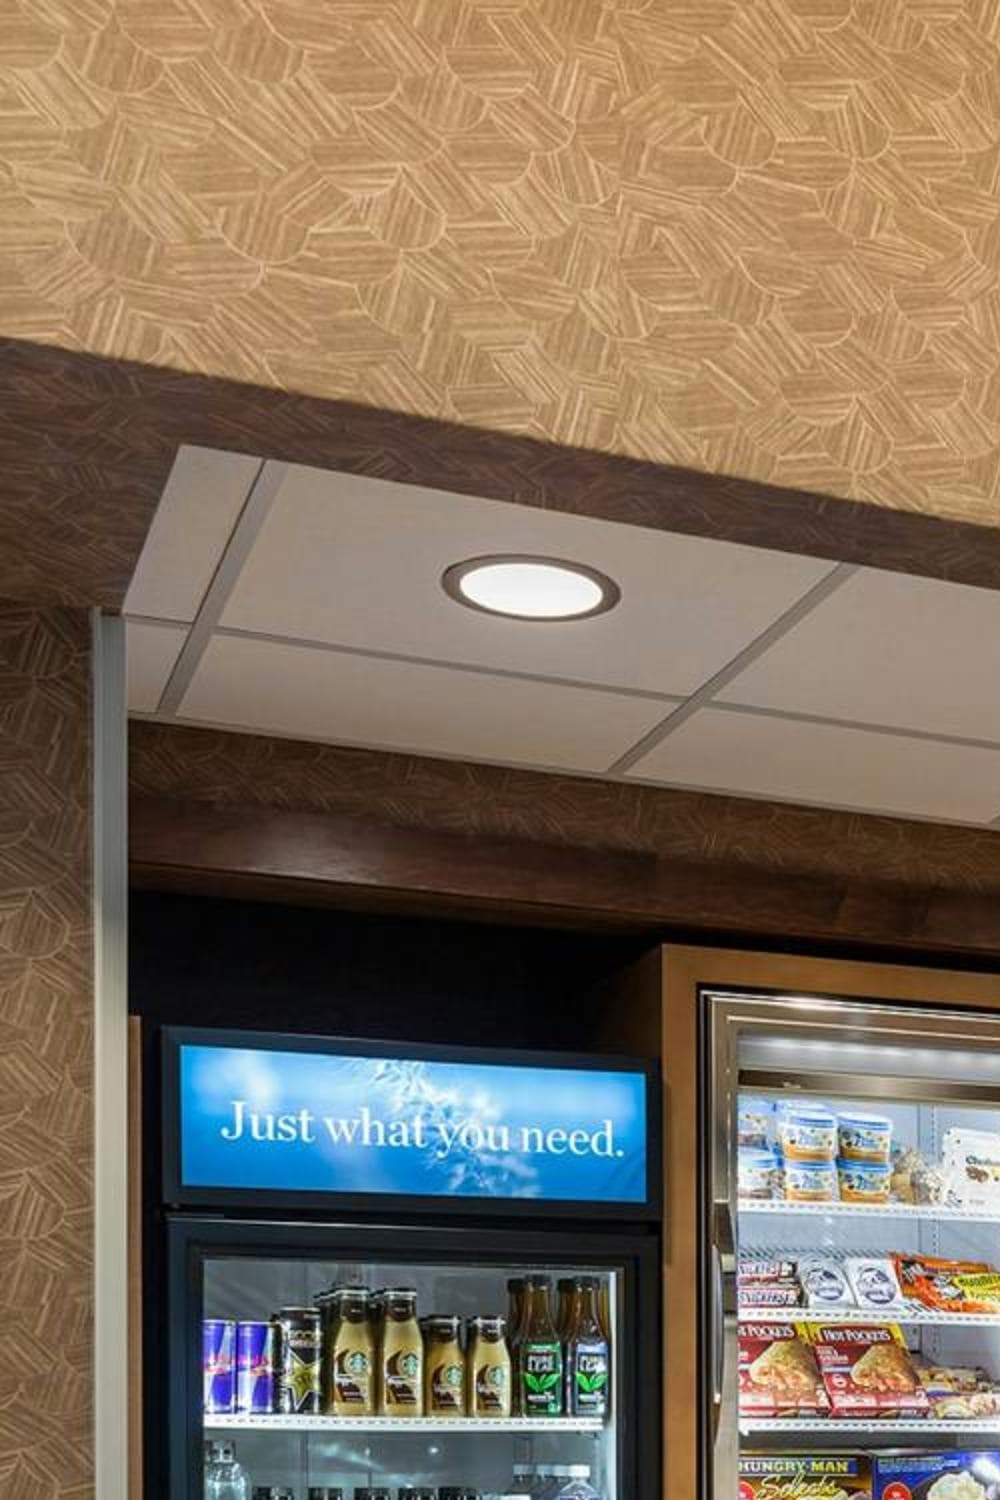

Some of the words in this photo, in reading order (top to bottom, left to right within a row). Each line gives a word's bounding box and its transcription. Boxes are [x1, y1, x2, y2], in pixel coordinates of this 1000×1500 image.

[220, 1100, 315, 1143] Just
[324, 1106, 428, 1149] what
[431, 1124, 510, 1158] you
[520, 1119, 626, 1158] need.
